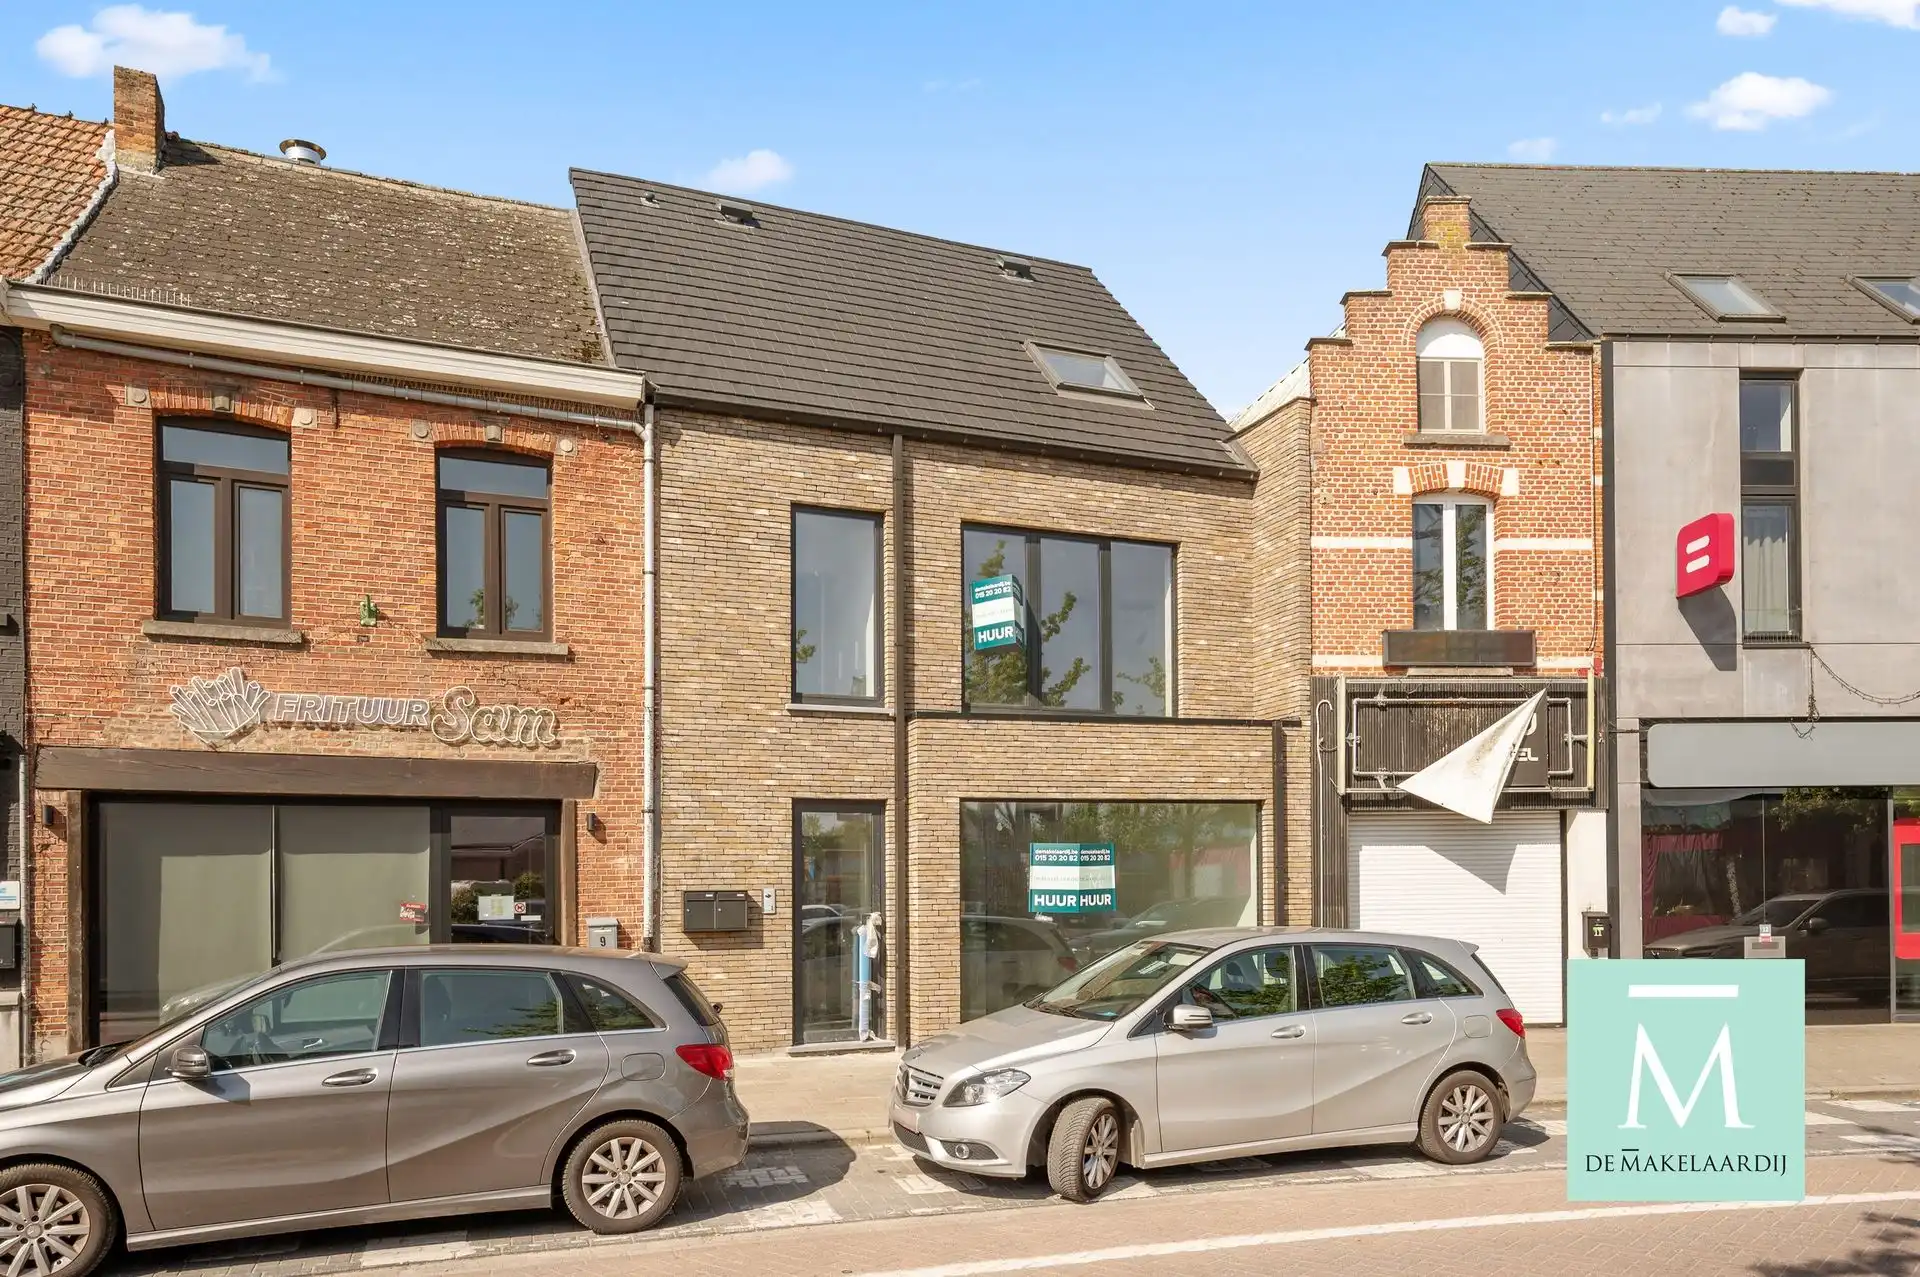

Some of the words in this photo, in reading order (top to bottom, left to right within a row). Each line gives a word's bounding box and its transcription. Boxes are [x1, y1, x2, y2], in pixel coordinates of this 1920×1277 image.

[975, 591, 985, 599] 015
[977, 626, 1014, 643] HUUR
[274, 693, 430, 726] FRITUUR
[431, 686, 556, 743] Sam
[1034, 848, 1078, 856] demakelaardij.be
[1034, 894, 1077, 907] HUUR
[1080, 894, 1112, 906] HUUR
[600, 936, 606, 947] 9
